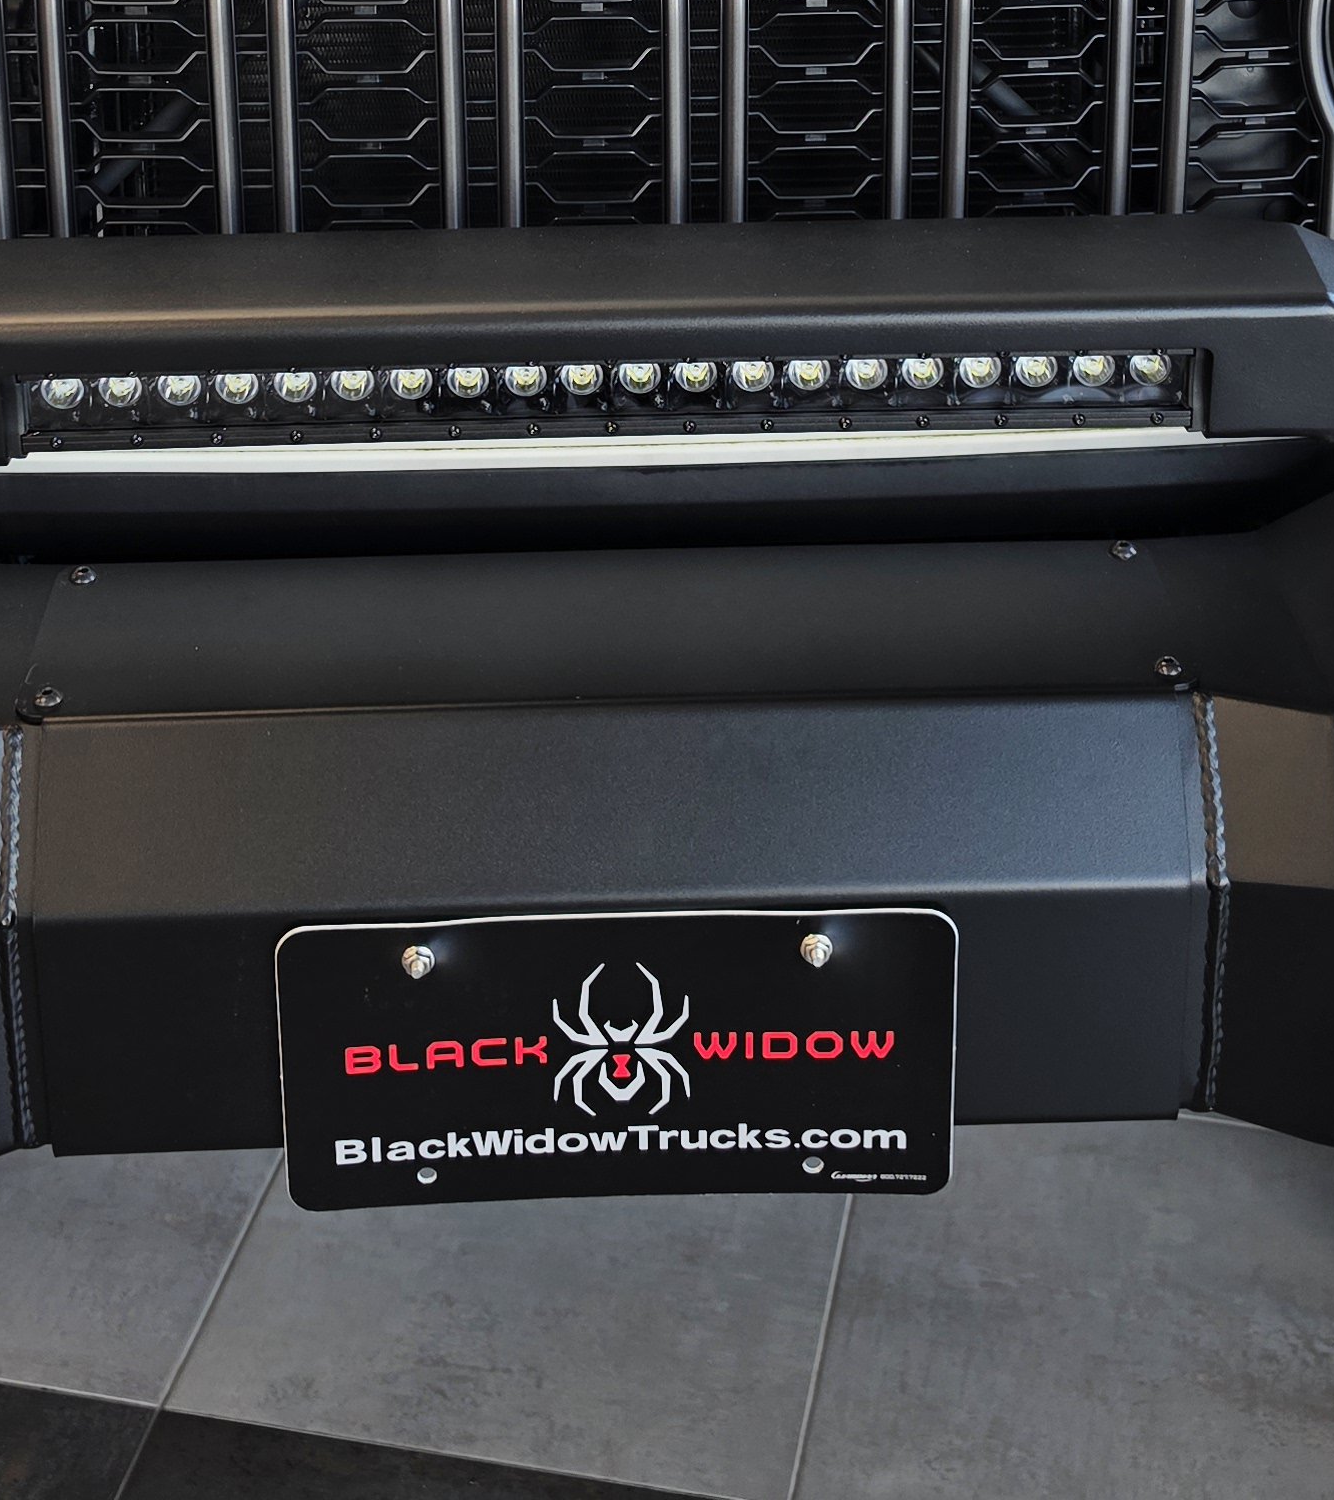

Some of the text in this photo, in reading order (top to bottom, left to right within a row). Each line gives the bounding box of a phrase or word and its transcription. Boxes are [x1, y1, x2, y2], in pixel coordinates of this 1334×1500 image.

[344, 1030, 895, 1075] BLACK WIDOW
[334, 1122, 907, 1166] BlackWidowTrucks.com
